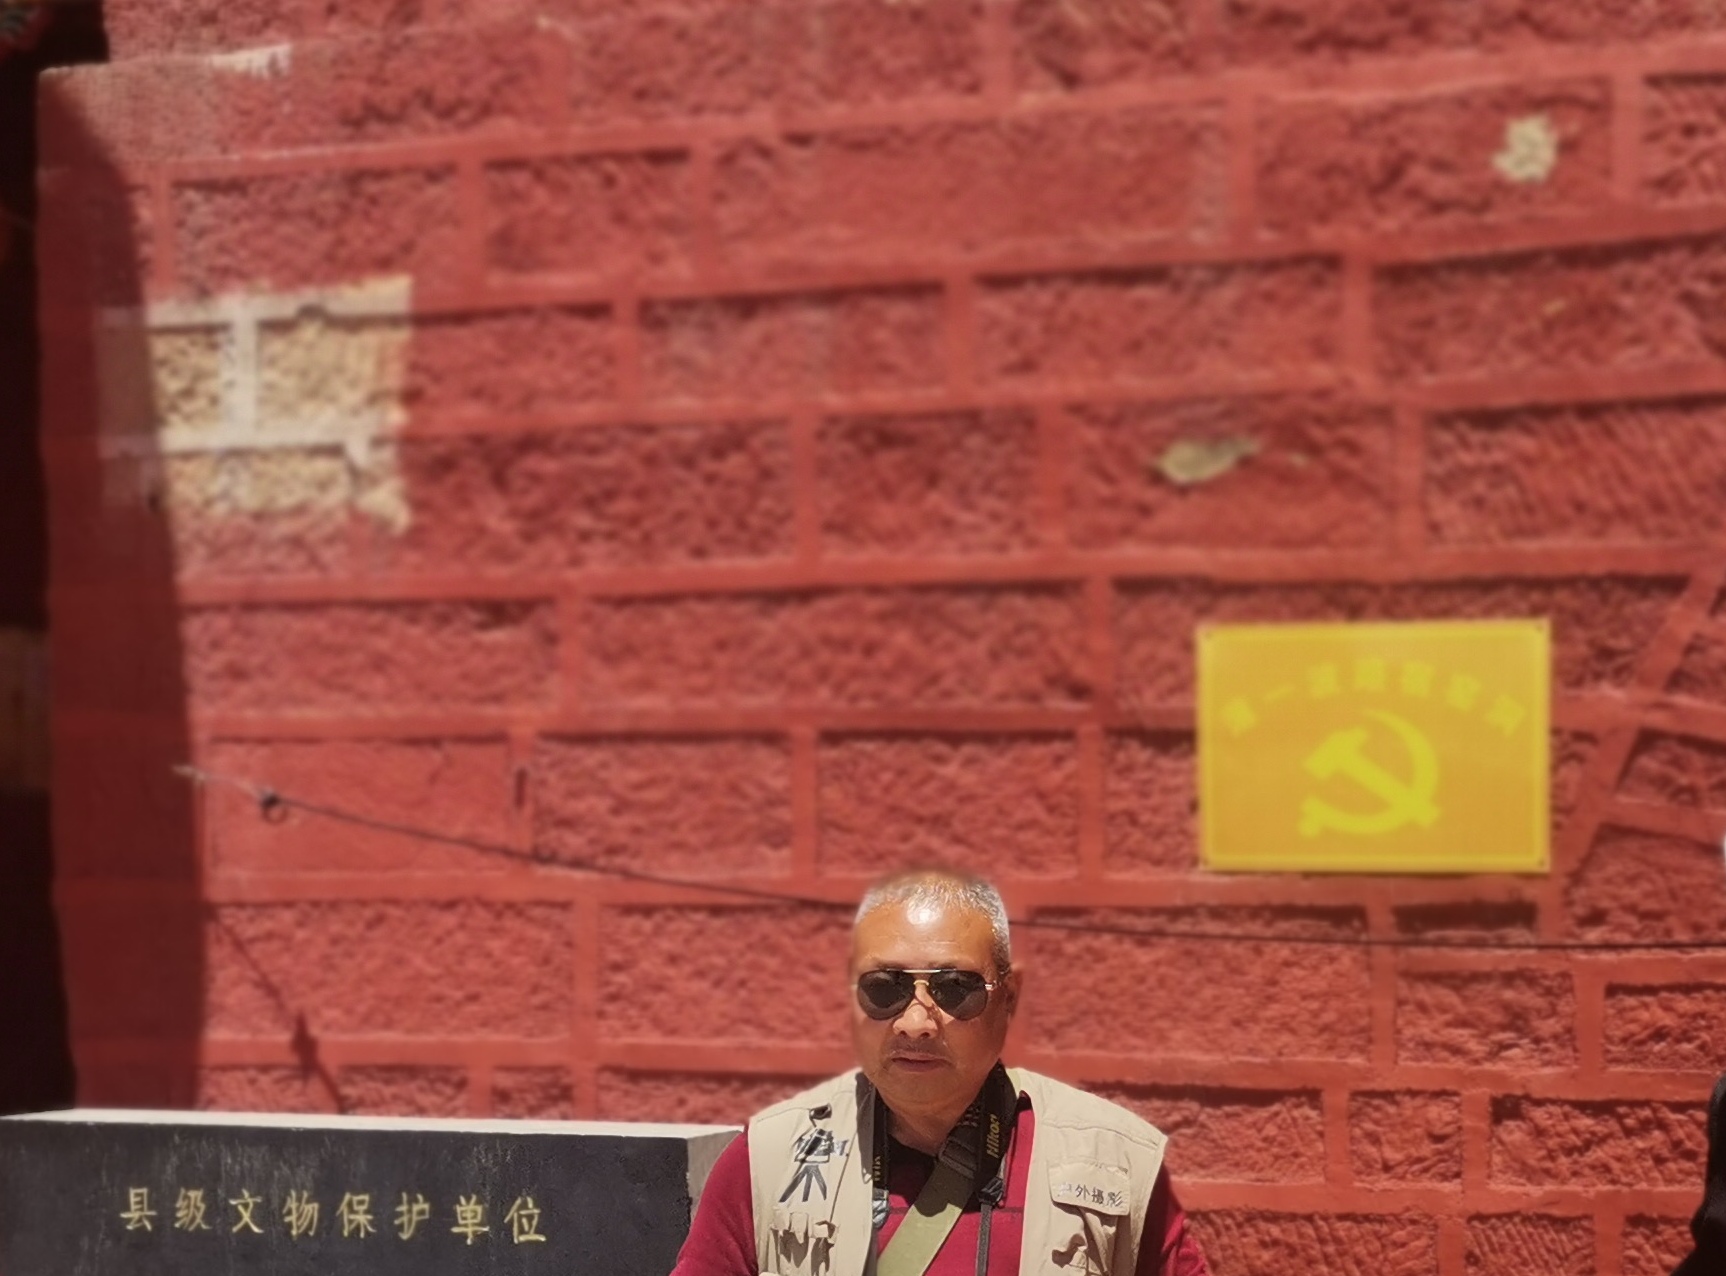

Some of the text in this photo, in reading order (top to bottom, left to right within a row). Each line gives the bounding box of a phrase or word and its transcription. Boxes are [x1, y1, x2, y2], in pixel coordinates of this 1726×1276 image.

[119, 1187, 547, 1245] 县级文物保护单位
